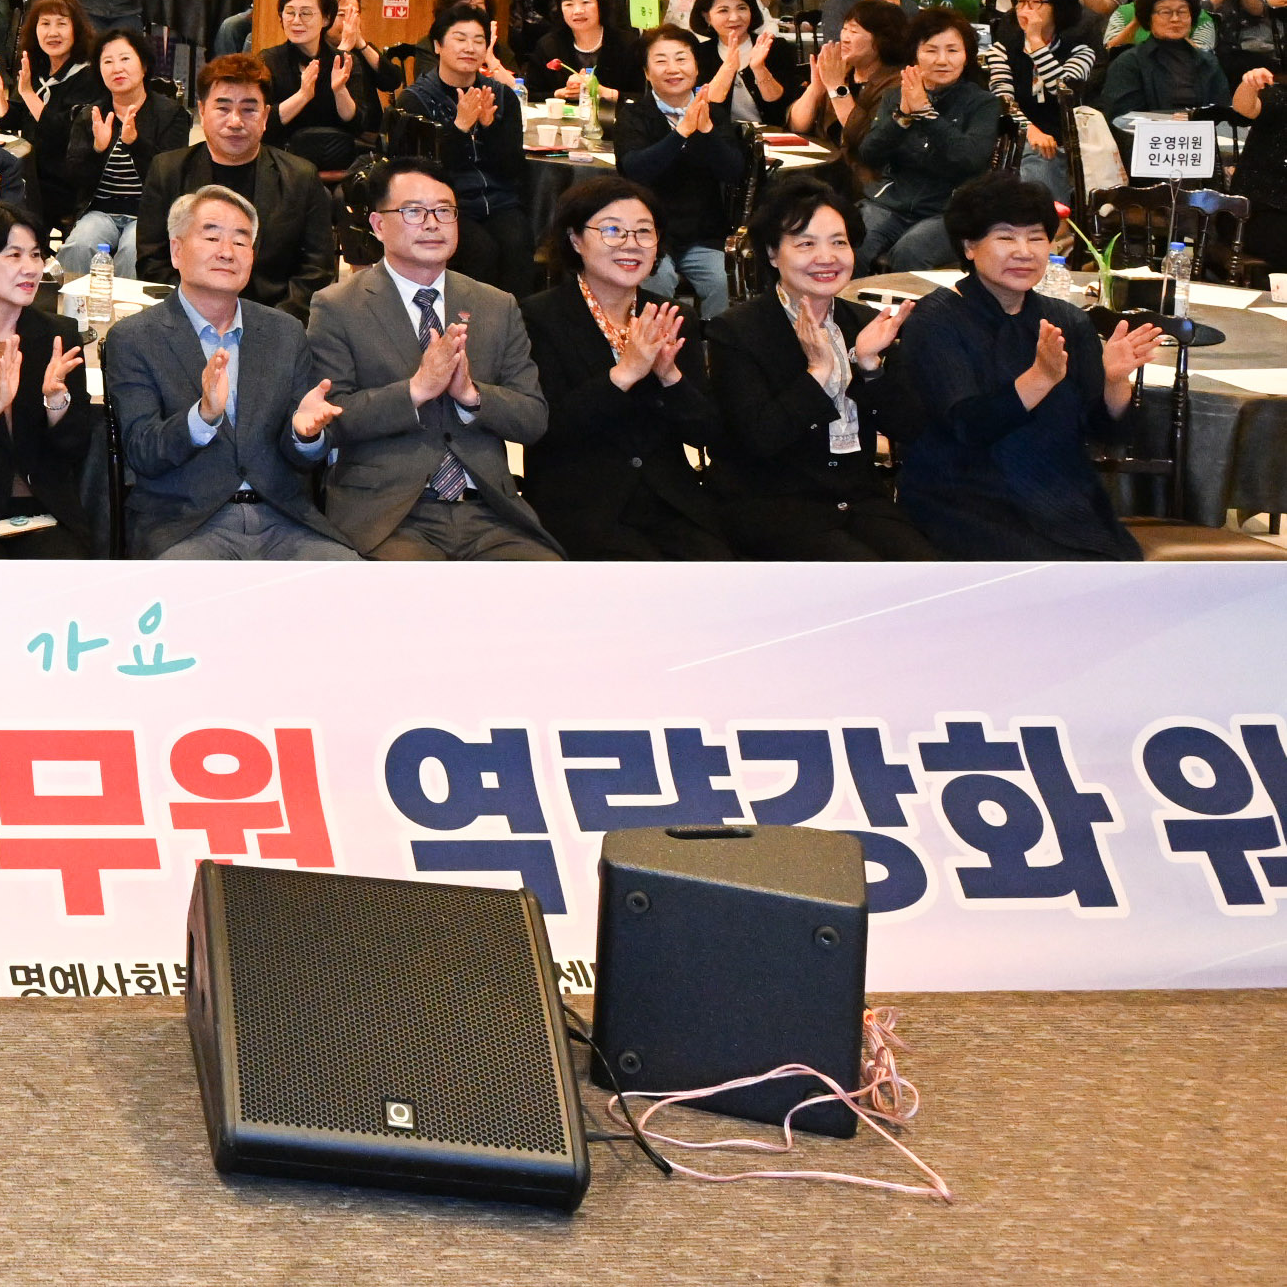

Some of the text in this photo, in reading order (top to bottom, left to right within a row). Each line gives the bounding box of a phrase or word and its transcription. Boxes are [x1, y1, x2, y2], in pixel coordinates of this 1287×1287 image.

[1148, 153, 1202, 166] 인사위원
[1149, 136, 1202, 150] 운영위원
[27, 602, 196, 677] 가요
[386, 721, 1118, 914] 역량강화
[10, 963, 188, 998] 명예사회
